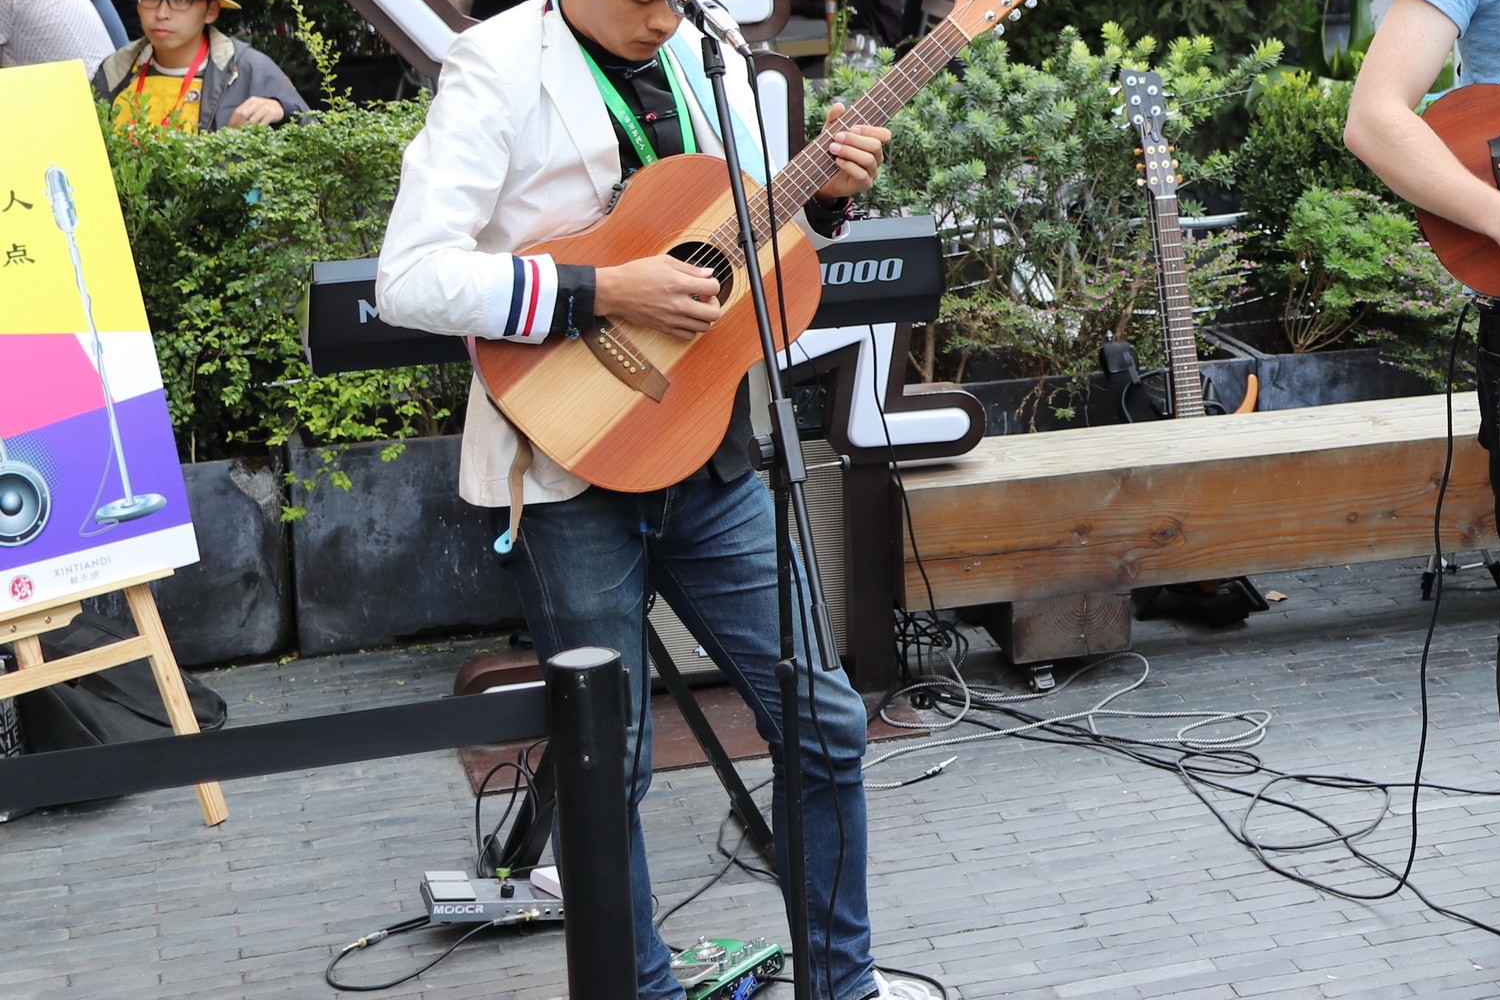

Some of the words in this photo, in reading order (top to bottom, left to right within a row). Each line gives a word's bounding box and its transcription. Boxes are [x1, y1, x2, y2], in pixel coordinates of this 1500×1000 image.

[2, 189, 33, 212] 人
[3, 243, 35, 268] 点
[54, 555, 112, 578] XINTIANDI
